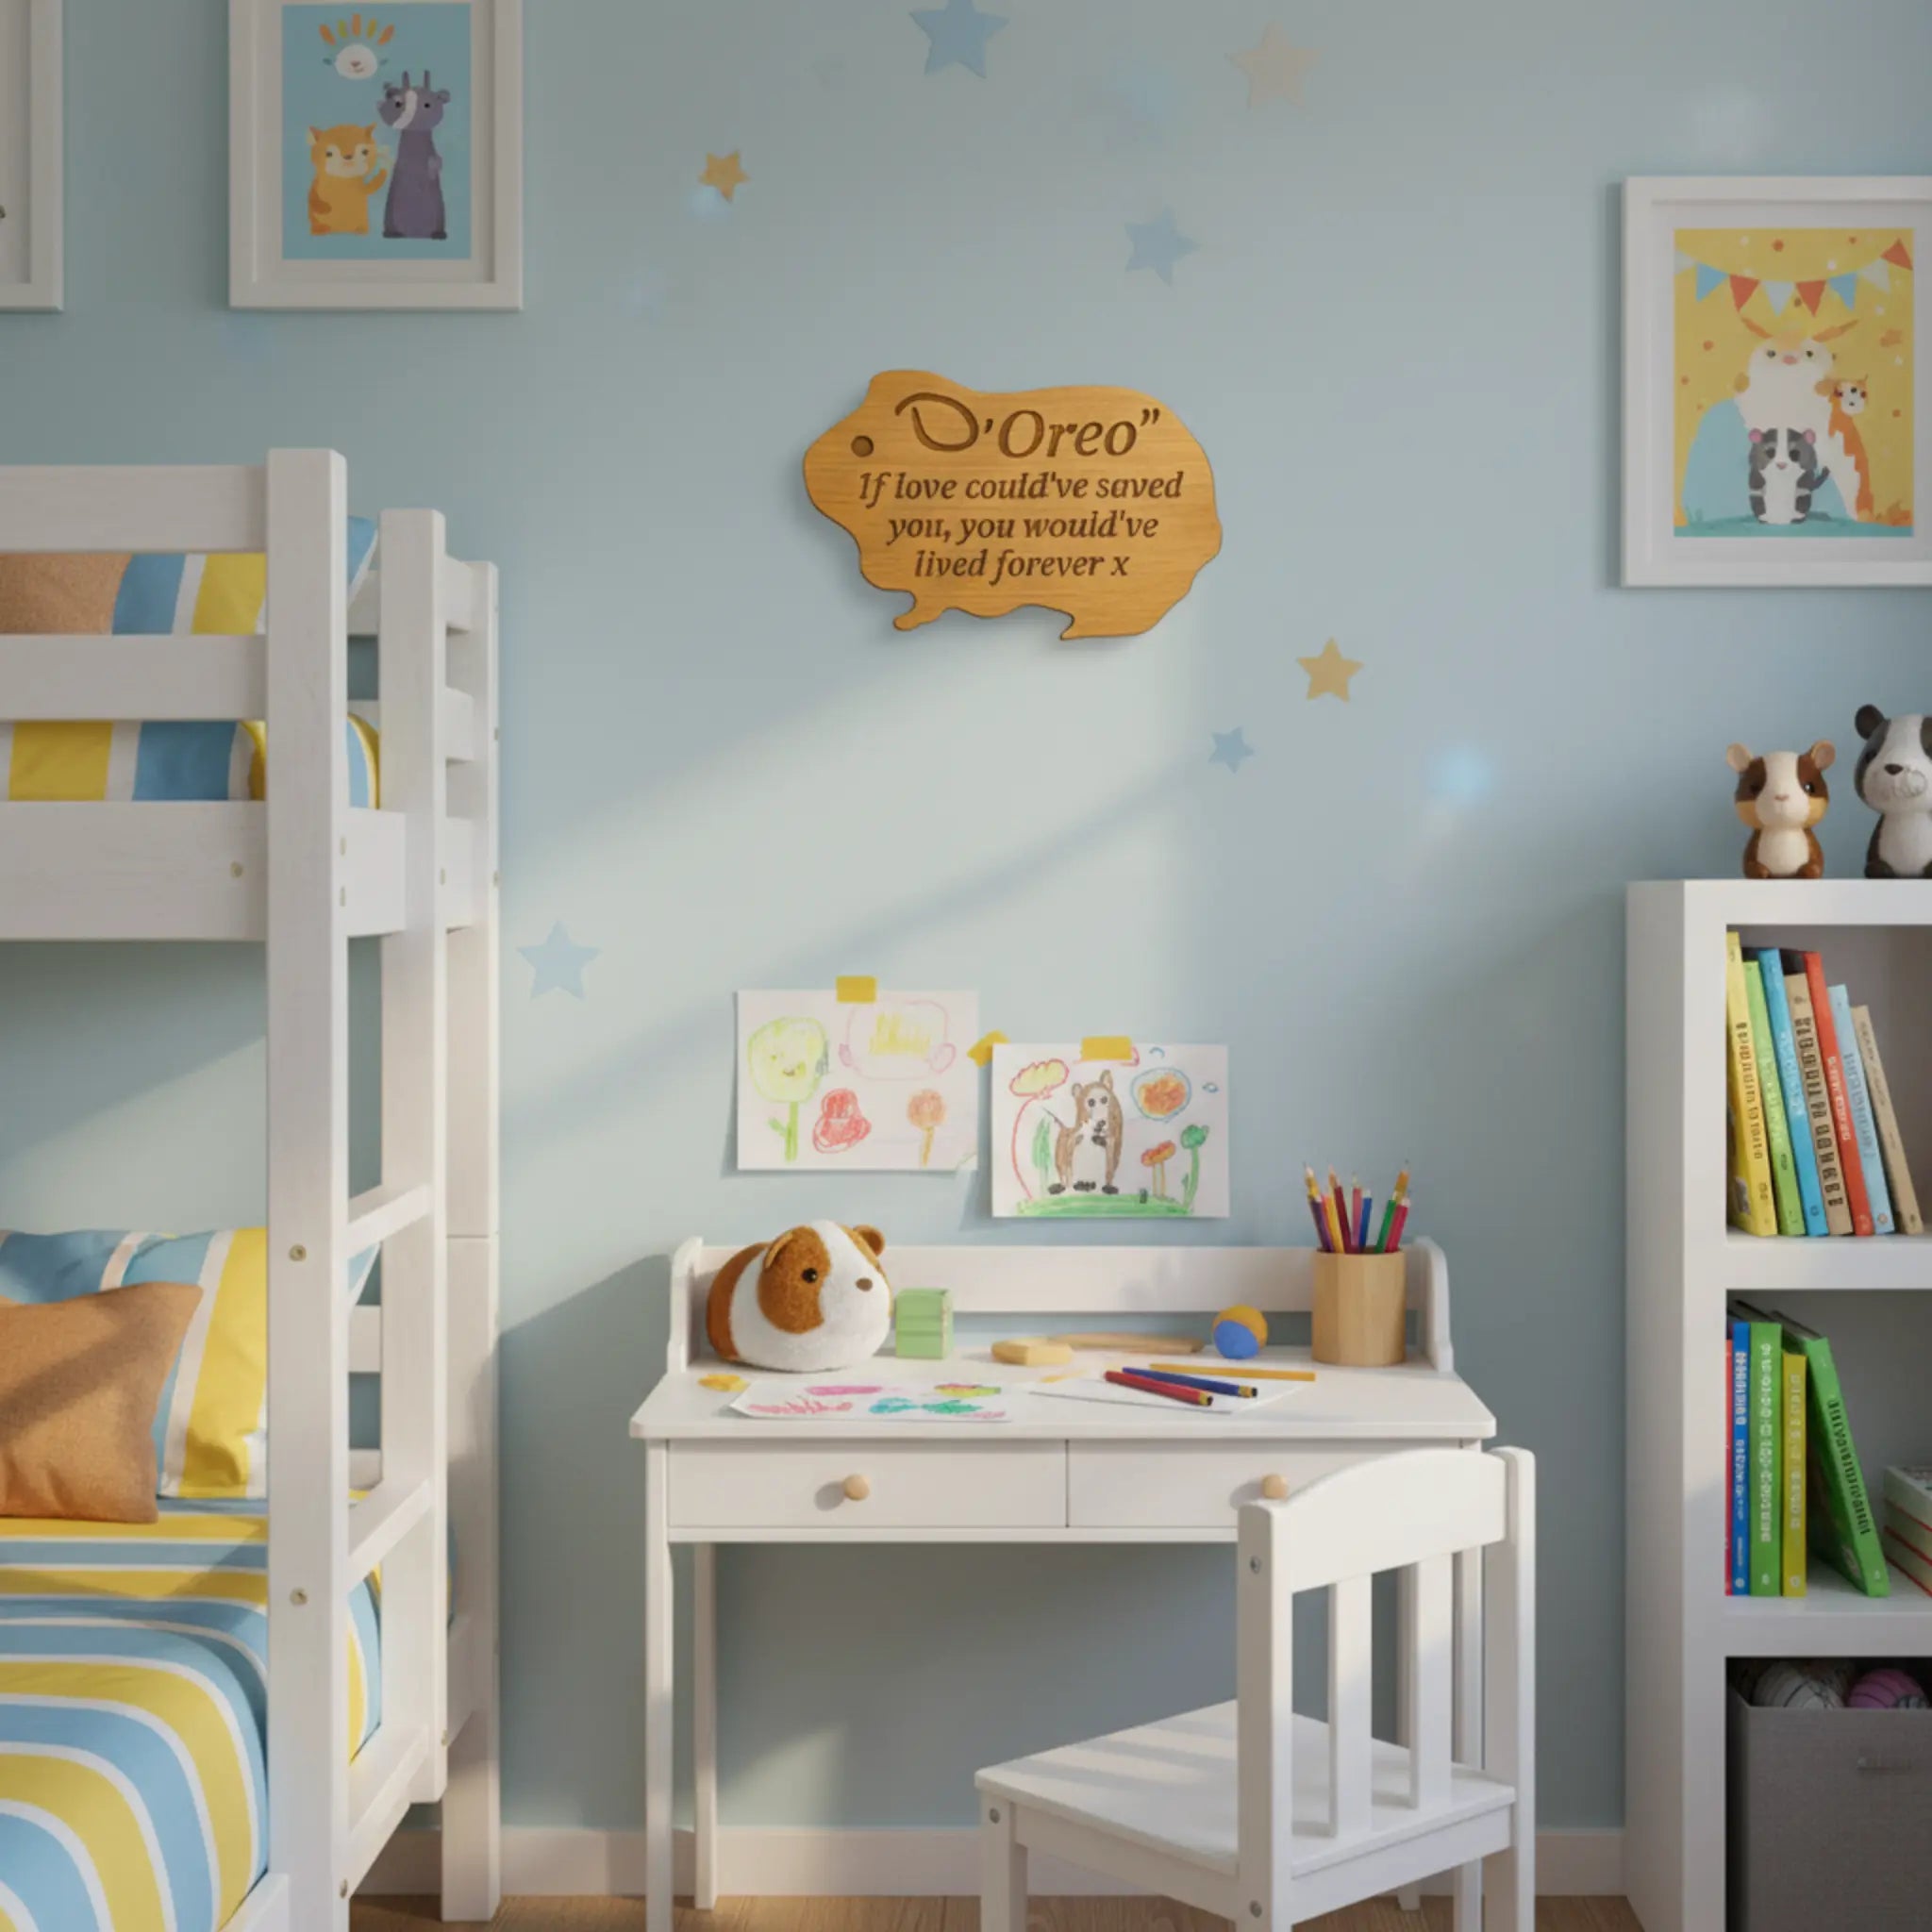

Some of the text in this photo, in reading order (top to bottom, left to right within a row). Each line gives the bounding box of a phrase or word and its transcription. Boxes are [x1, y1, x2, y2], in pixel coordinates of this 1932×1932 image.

[859, 471, 1184, 509] If love could've saved
[886, 510, 1158, 546] you, you would've
[915, 549, 1130, 587] lived forever x
